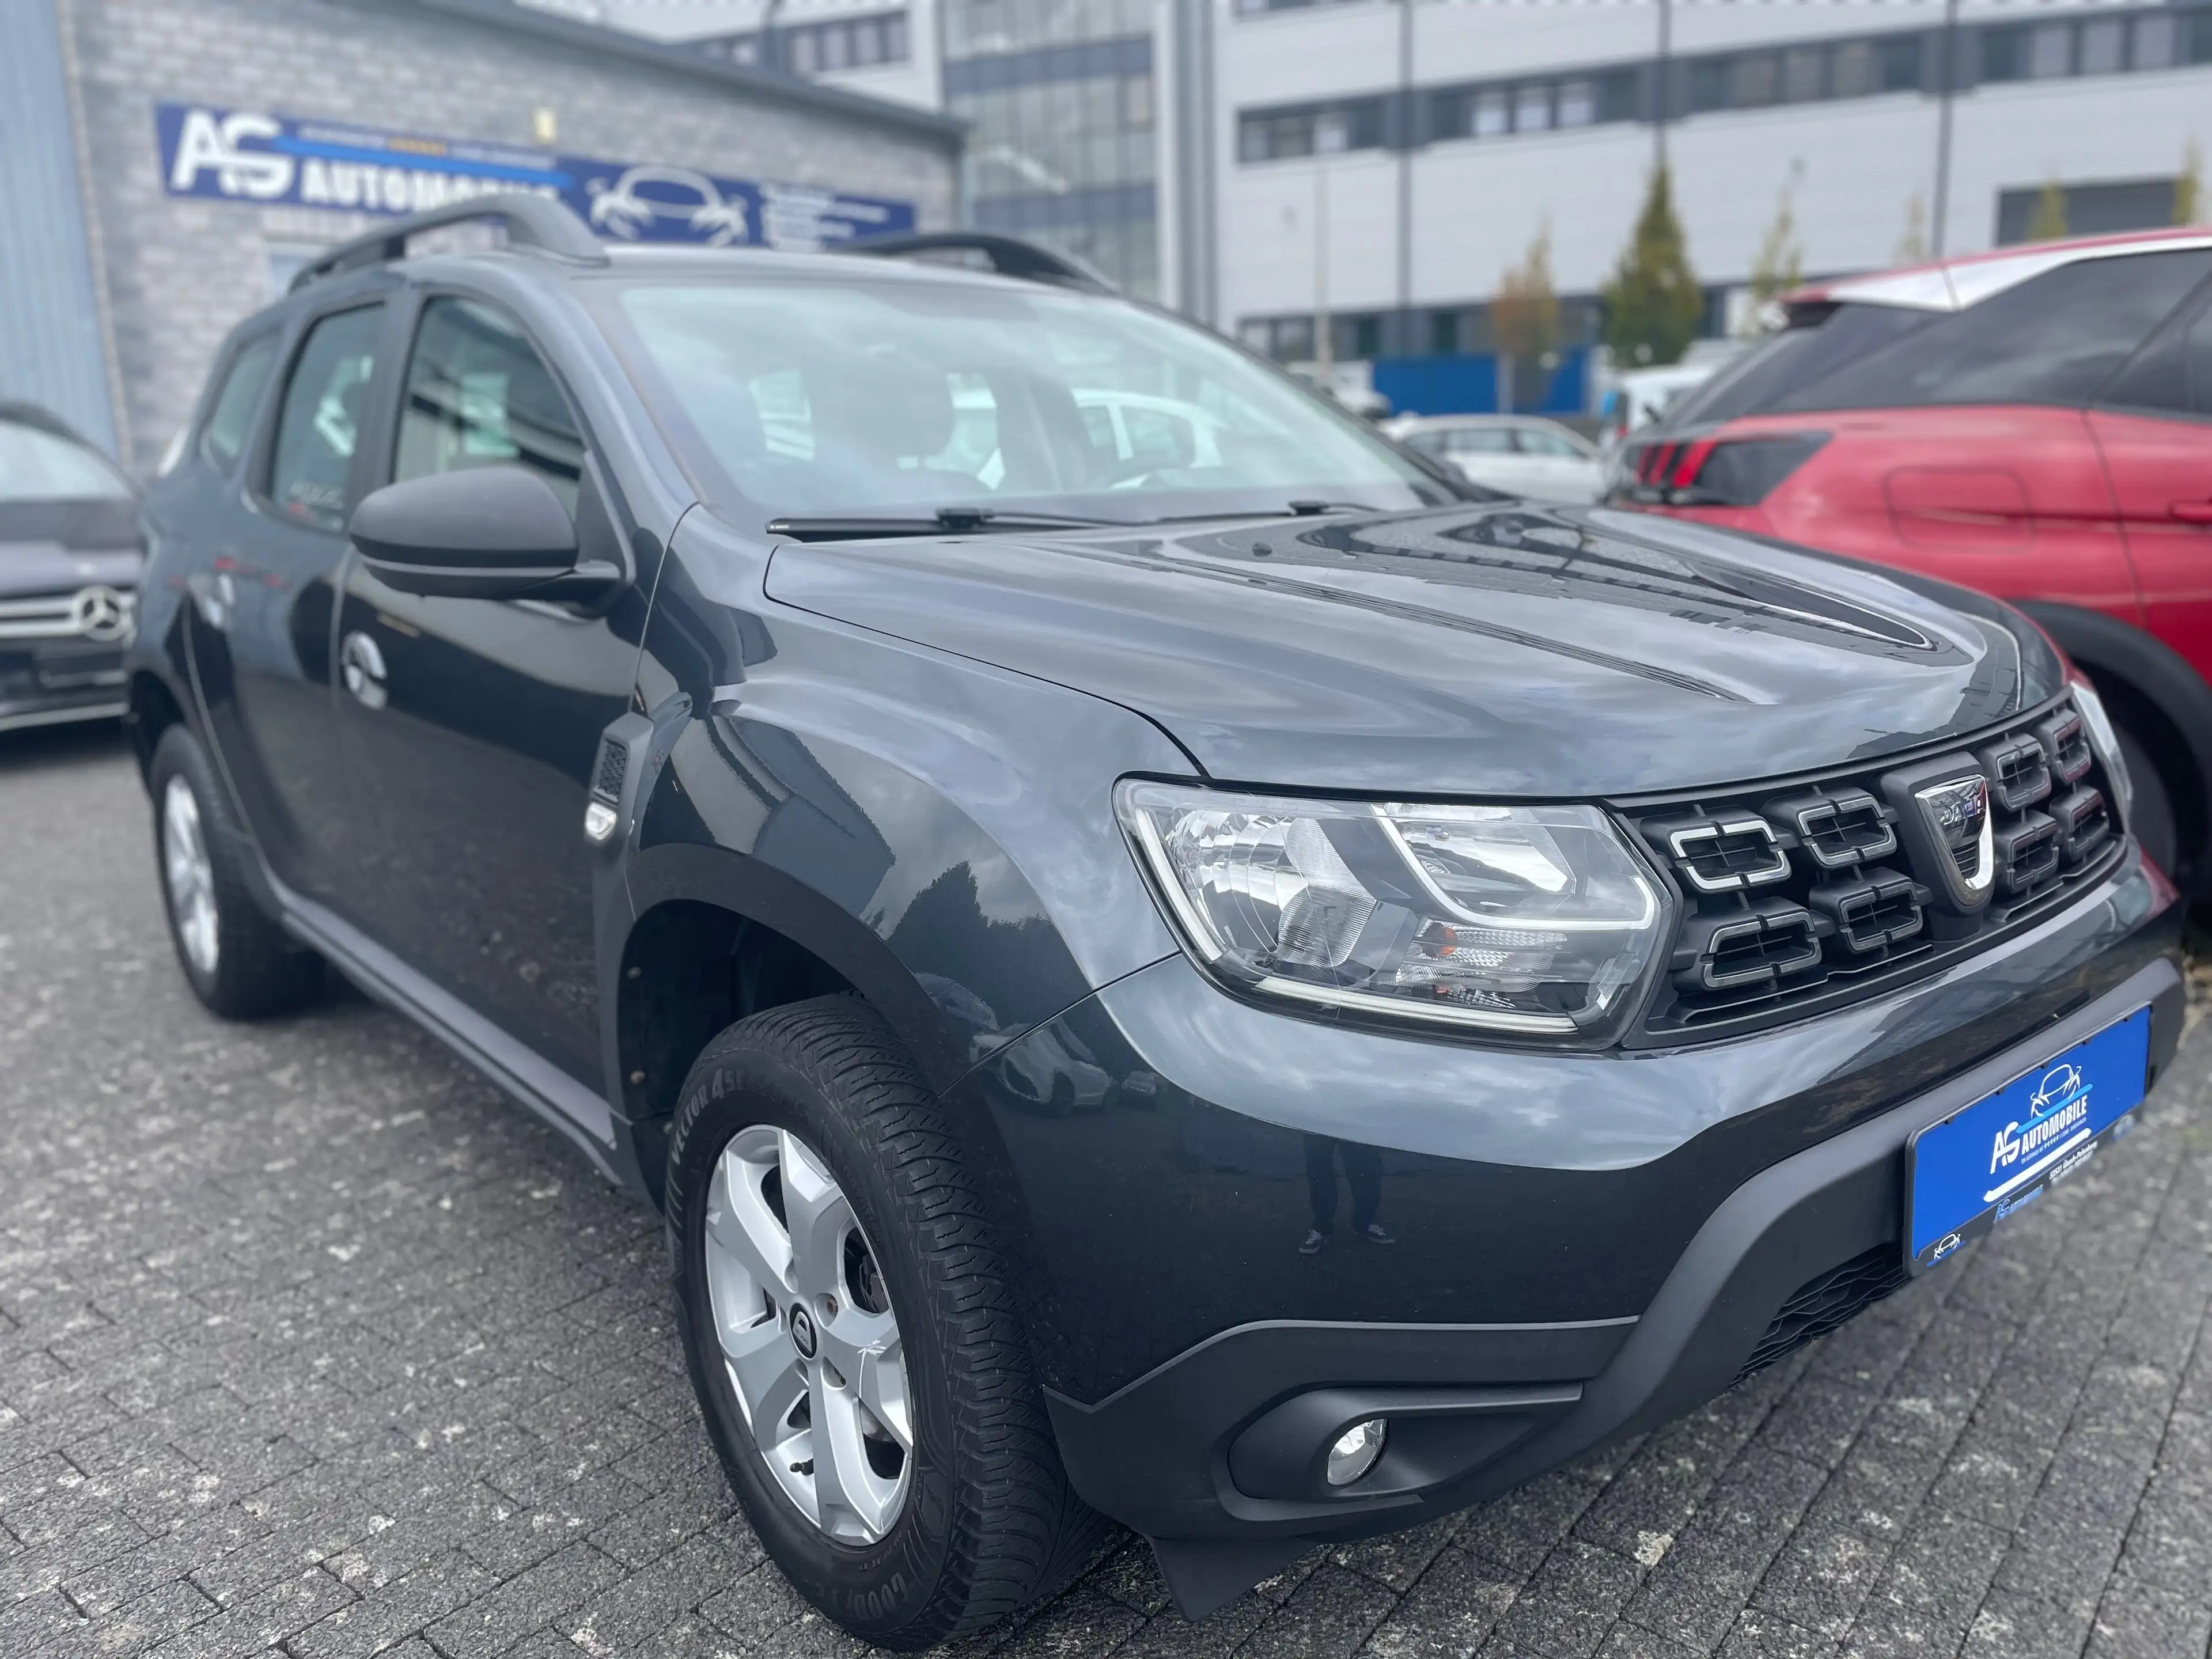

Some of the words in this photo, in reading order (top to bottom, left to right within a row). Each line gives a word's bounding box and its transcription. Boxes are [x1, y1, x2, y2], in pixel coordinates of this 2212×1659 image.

[170, 108, 295, 199] AS
[301, 156, 558, 212] AUTOMO
[672, 1084, 709, 1165] VECTOR
[1990, 1121, 2021, 1174] AS
[2021, 1094, 2088, 1155] AUTOMOBILE
